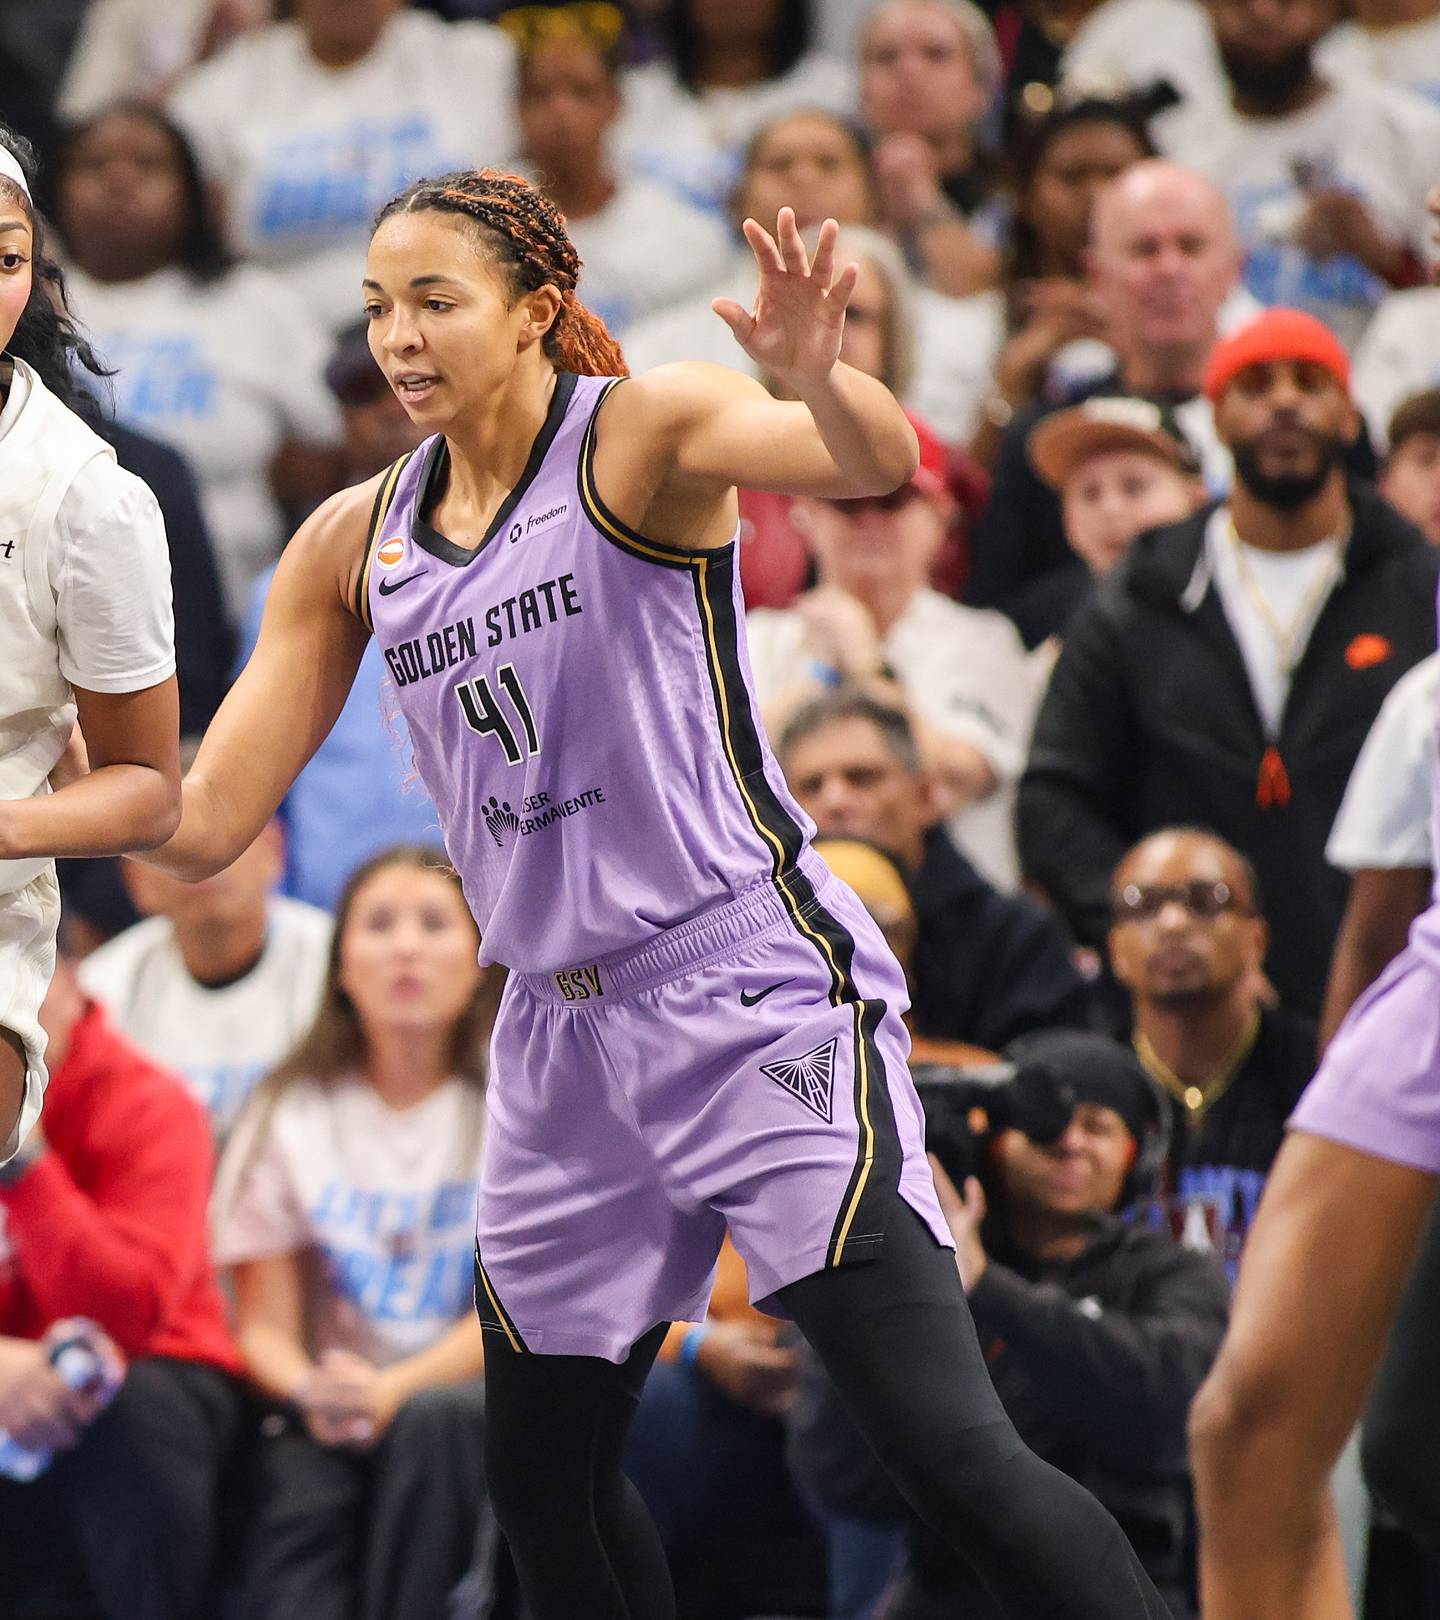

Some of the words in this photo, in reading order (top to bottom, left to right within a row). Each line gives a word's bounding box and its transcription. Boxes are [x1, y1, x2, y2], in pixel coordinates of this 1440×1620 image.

[526, 504, 567, 534] freedom
[384, 617, 478, 687] GOLDEN
[485, 572, 583, 648] STATE
[454, 662, 541, 767] 41
[554, 964, 604, 1001] GSV
